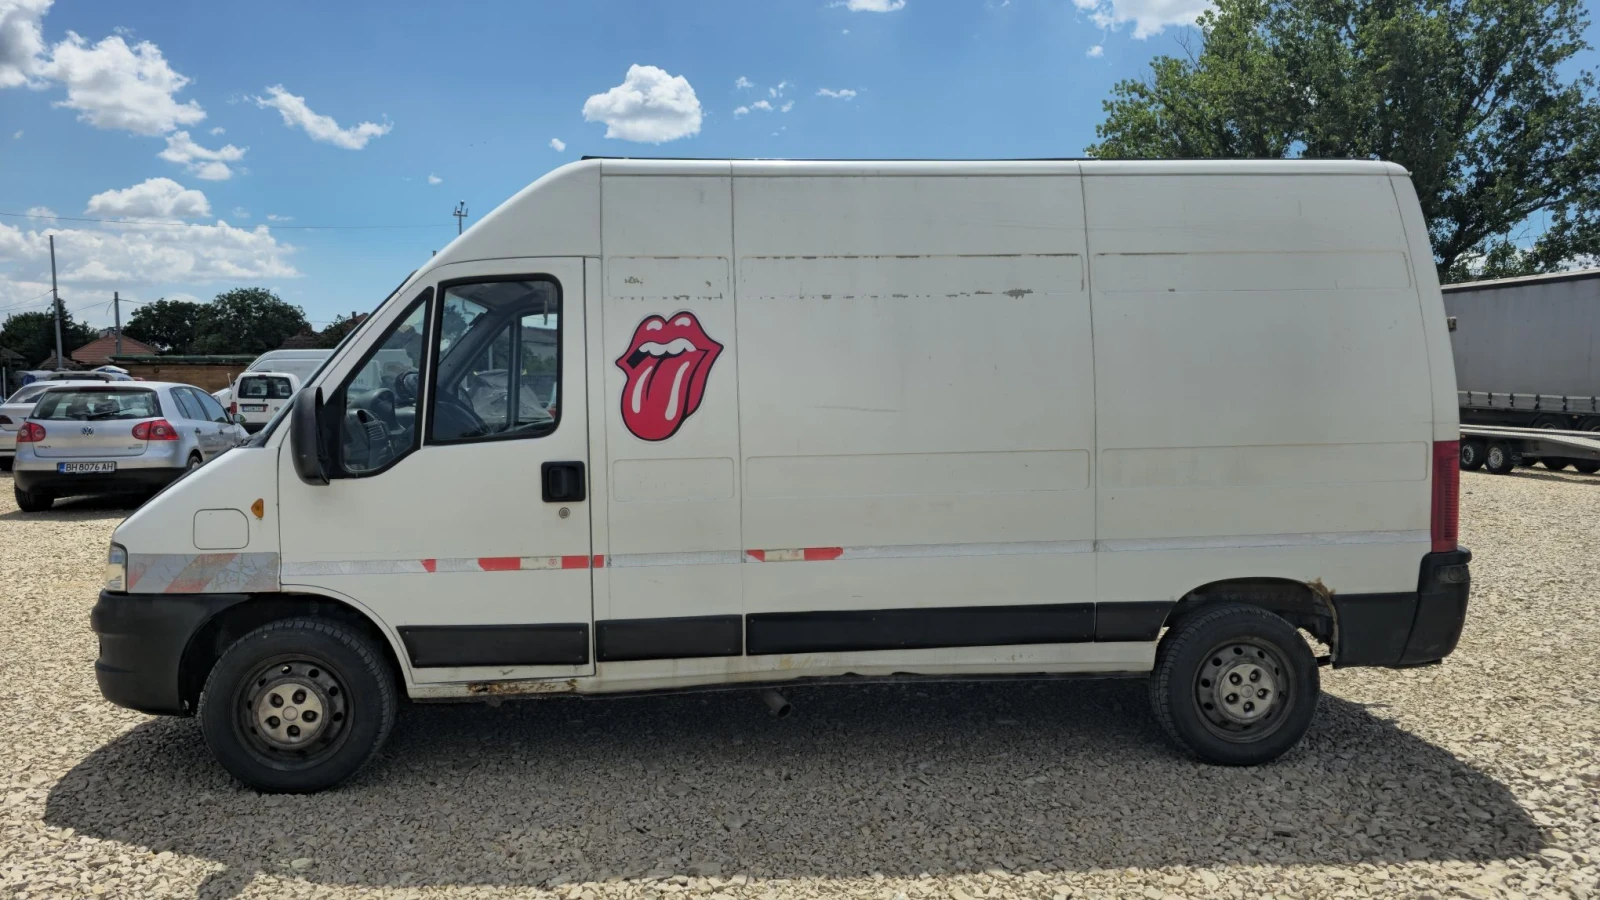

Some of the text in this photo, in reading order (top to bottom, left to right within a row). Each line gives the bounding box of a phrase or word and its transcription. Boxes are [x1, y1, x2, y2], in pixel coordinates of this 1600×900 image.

[66, 463, 113, 471] BH 8076 AH
